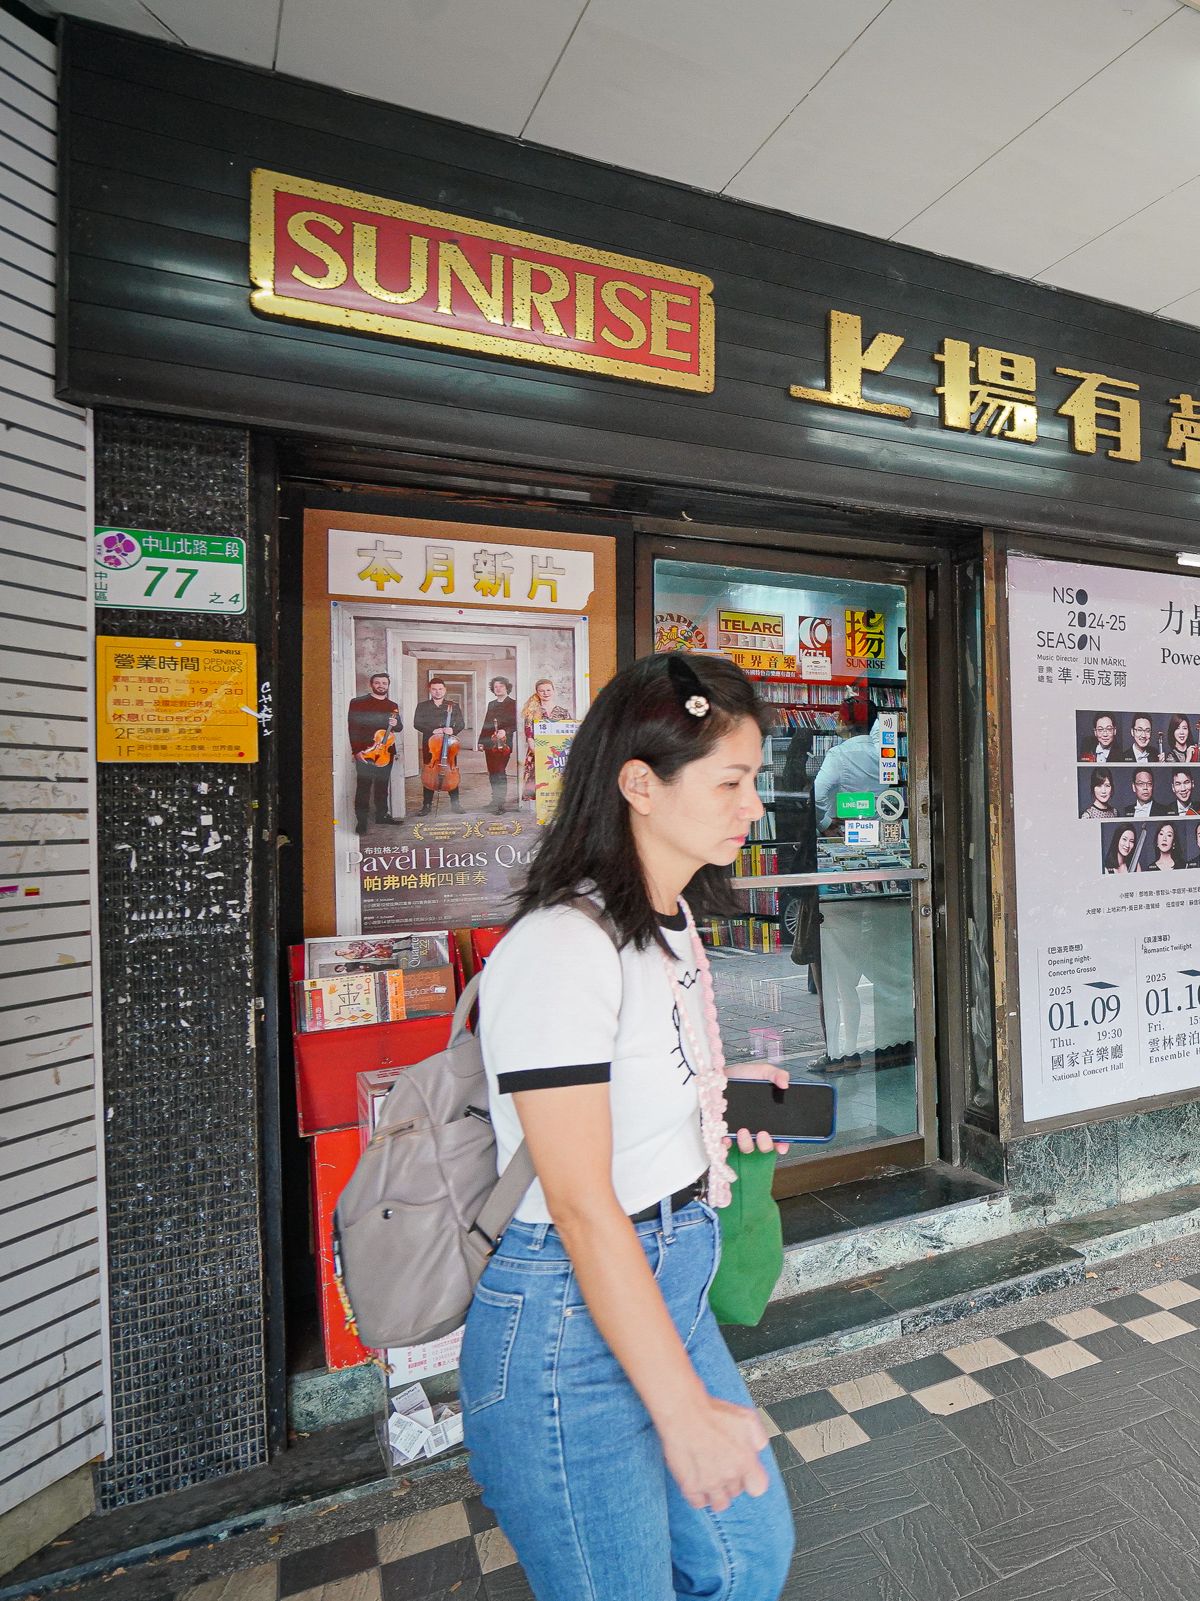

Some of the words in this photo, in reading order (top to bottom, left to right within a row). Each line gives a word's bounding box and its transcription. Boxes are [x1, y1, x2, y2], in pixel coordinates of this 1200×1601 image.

[286, 210, 693, 362] SUNRISE
[142, 535, 240, 559] 中山北路二段
[357, 540, 566, 602] 本月新片
[143, 565, 199, 598] 77
[1053, 586, 1089, 606] NSO
[721, 618, 783, 634] TELARC
[1067, 610, 1127, 632] 2024-25
[719, 632, 784, 650] DIGITAL
[1036, 630, 1101, 652] SEASON
[113, 653, 200, 672] 營業時間
[203, 657, 243, 666] OPENING
[734, 653, 796, 669] 世界音樂
[846, 657, 886, 670] SUNRISE
[1036, 653, 1054, 662] Music
[1055, 655, 1079, 663] Director
[1083, 656, 1099, 665] JUN
[203, 665, 243, 673] HOURS
[114, 727, 135, 740] 2F
[117, 745, 136, 756] 1F
[855, 822, 874, 830] Push
[364, 845, 410, 855] 布拉格之春
[345, 848, 417, 873] Pavel
[424, 847, 488, 869] Haas
[363, 870, 489, 892] 帕弗哈斯四重奏
[1143, 945, 1170, 955] Romantic
[1170, 943, 1192, 952] Twilight
[1048, 956, 1074, 966] Opening
[1048, 967, 1076, 978] Concerto
[1076, 965, 1097, 974] Grosso
[1145, 973, 1167, 983] 2025
[1049, 985, 1072, 997] 2025
[1048, 994, 1121, 1032] 01.09
[1147, 1022, 1165, 1033] Fri.
[1050, 1036, 1076, 1049] Thu.
[1096, 1028, 1123, 1042] 19:30
[1051, 1043, 1124, 1071] 國家音樂廳
[1149, 1050, 1191, 1064] Ensemble
[1051, 1070, 1081, 1083] National
[1082, 1065, 1109, 1077] Concert
[1110, 1062, 1124, 1071] Hall
